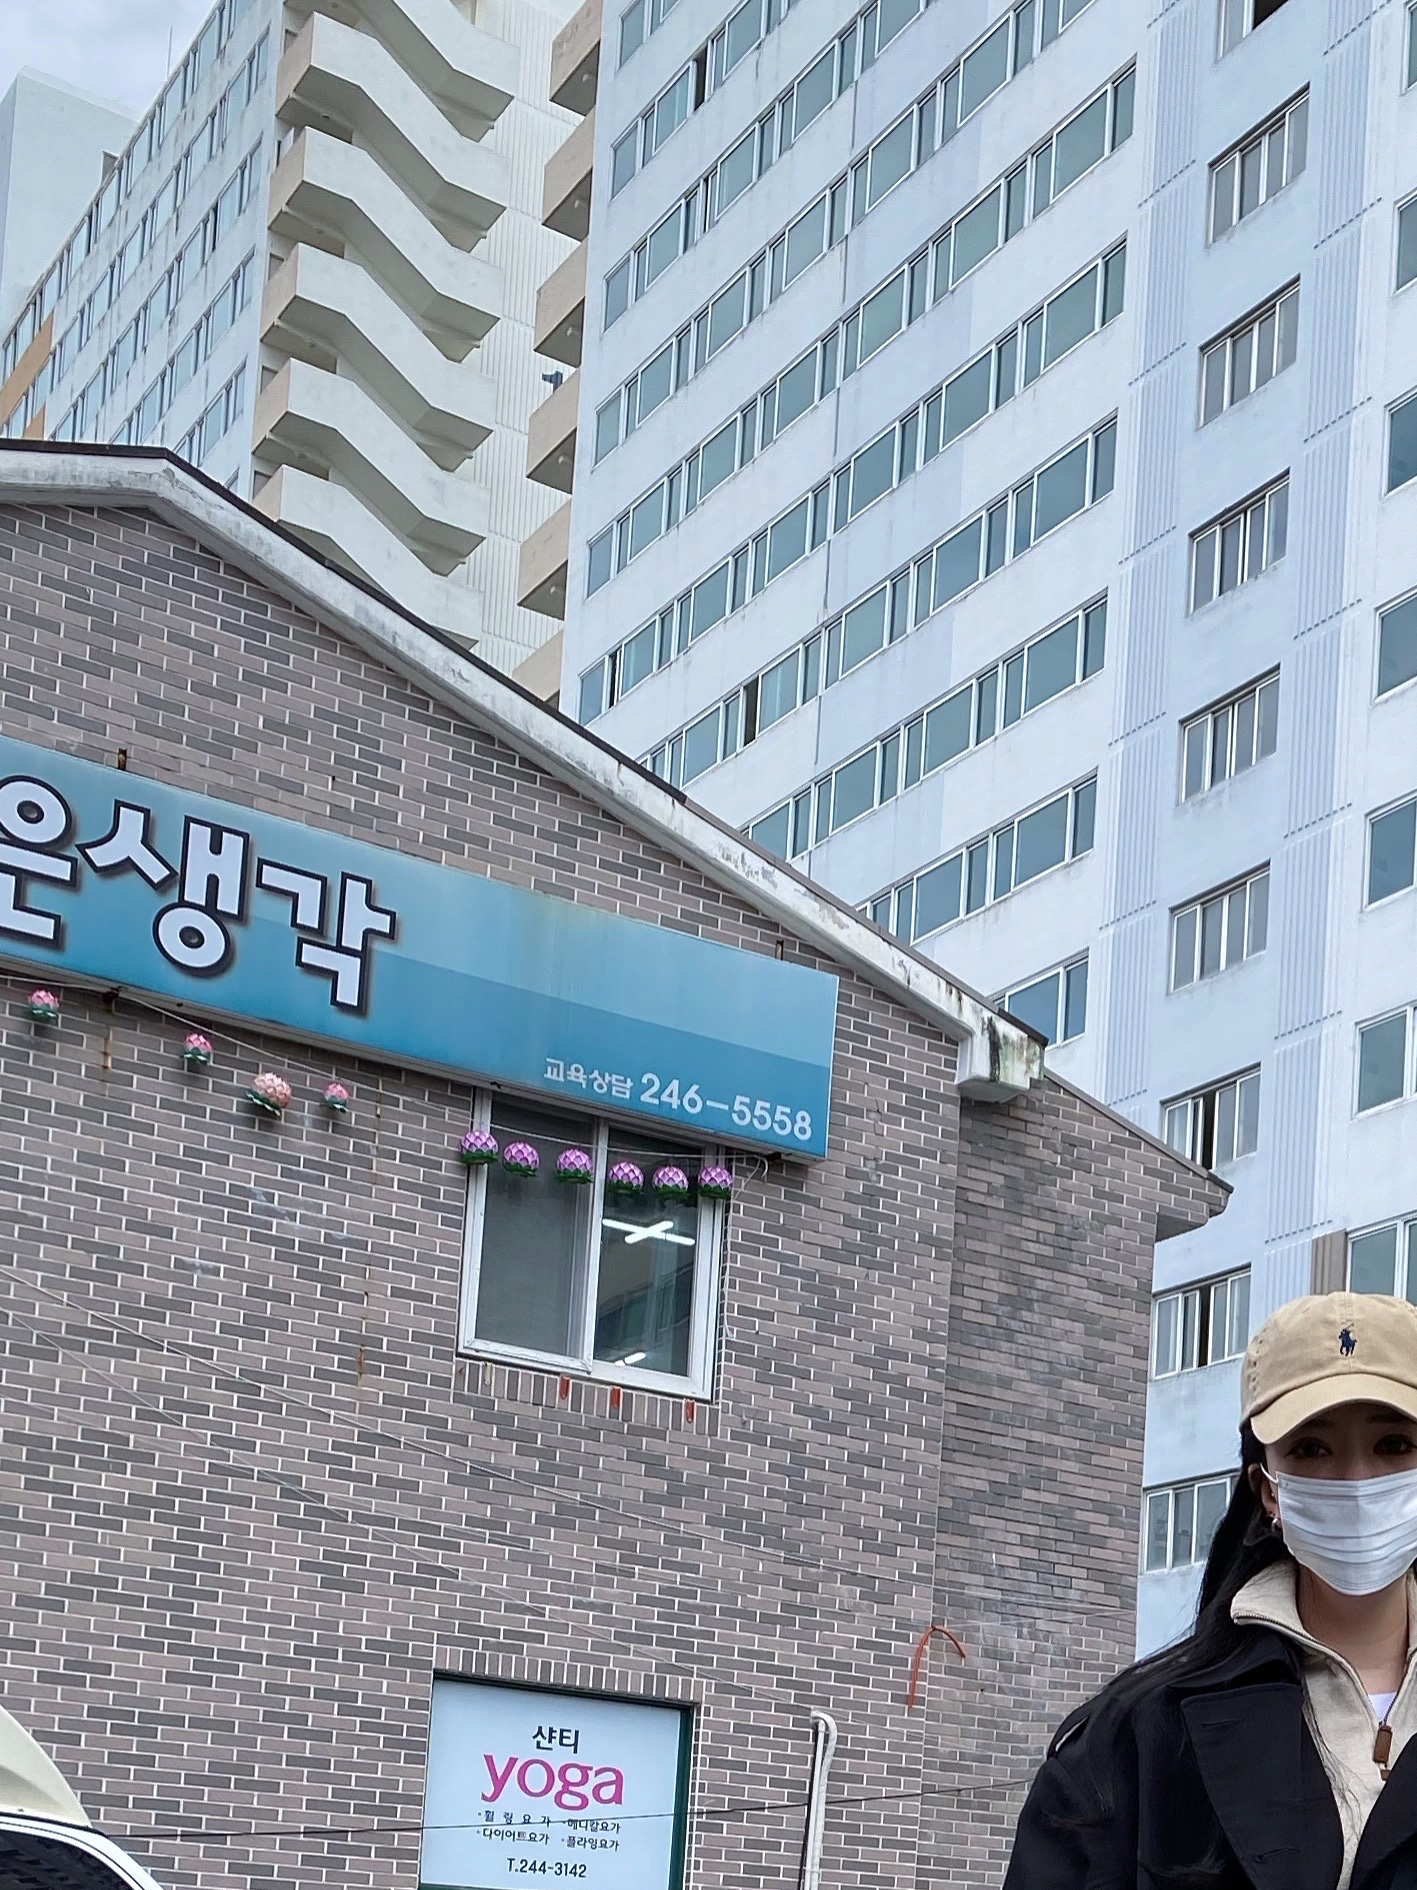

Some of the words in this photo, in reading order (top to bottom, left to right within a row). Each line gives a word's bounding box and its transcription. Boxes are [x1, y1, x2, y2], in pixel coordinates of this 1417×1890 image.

[543, 1057, 634, 1100] 교육상담
[639, 1072, 813, 1141] 246-5558
[532, 1725, 580, 1755] 샨티
[480, 1753, 625, 1812] yoga
[482, 1828, 550, 1846] 다이어트요가
[566, 1835, 620, 1852] 플라잉요가
[506, 1857, 588, 1879] T.244-3142
